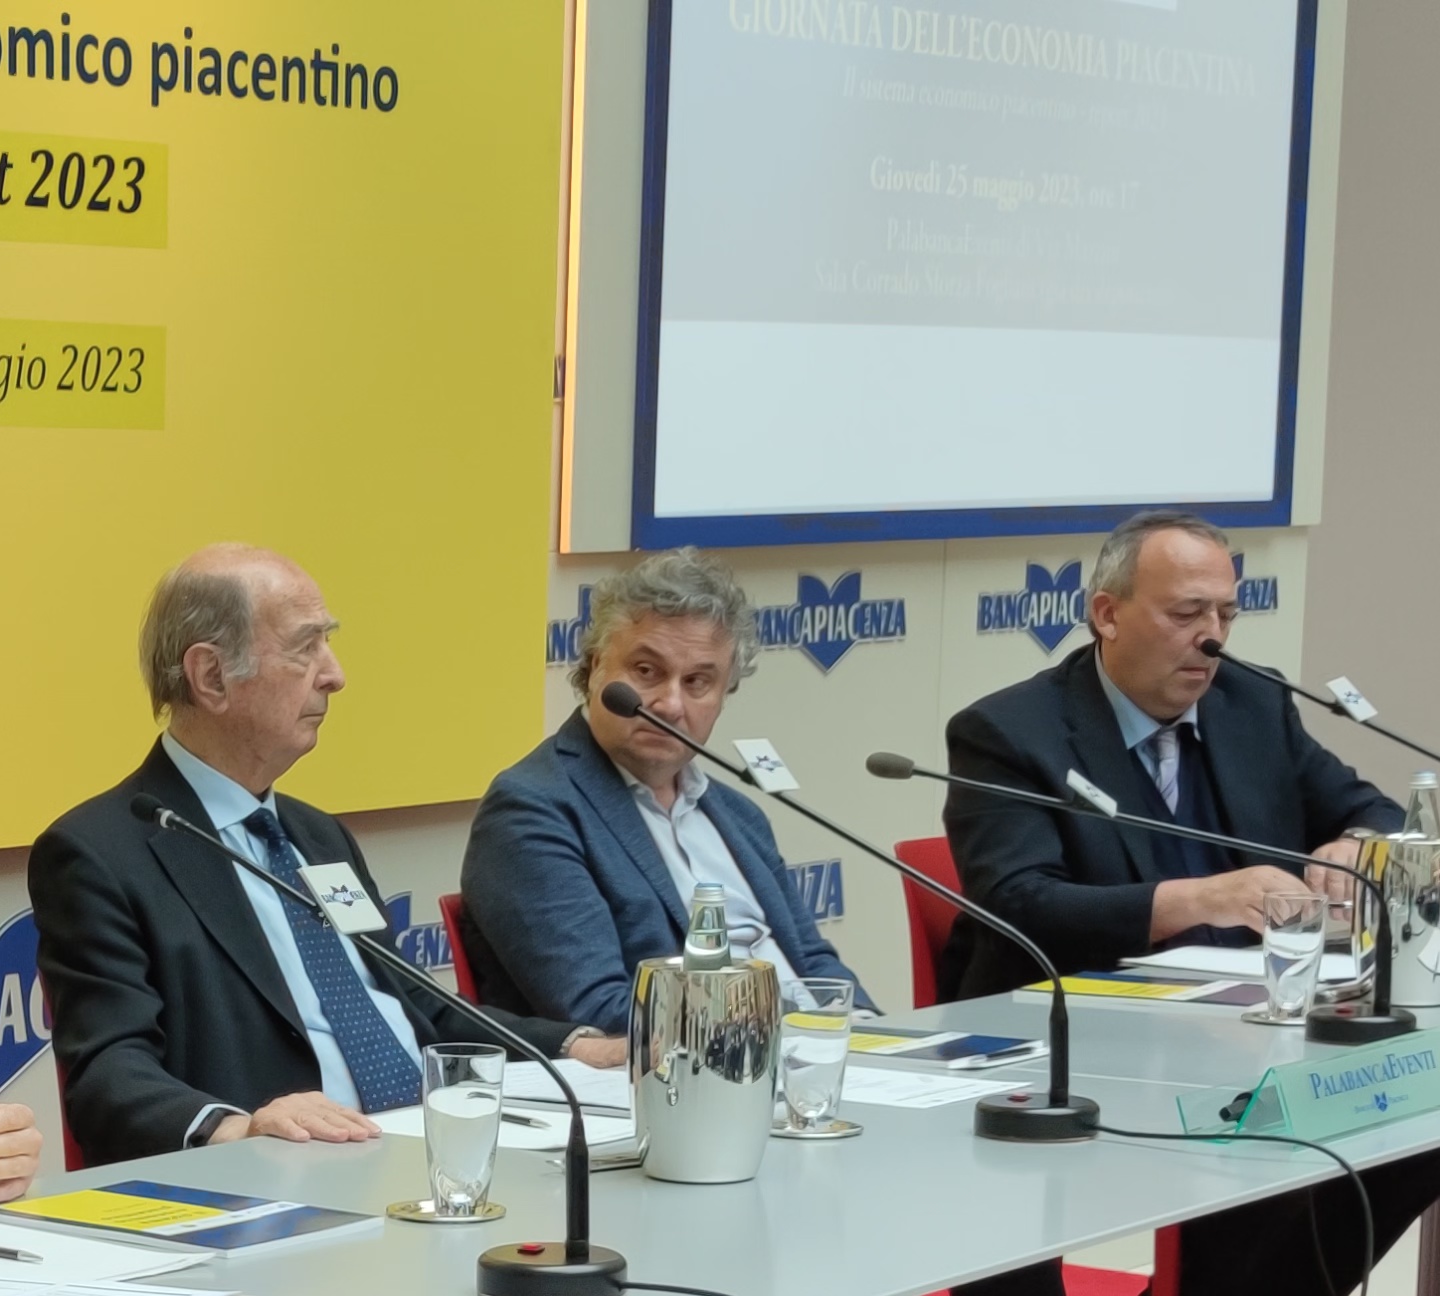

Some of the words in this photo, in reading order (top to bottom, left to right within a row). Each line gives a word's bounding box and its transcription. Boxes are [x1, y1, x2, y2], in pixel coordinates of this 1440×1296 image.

[151, 27, 399, 112] piacentino
[729, 0, 884, 48] GIORNATA
[891, 6, 1109, 79] DELL'ECONOMIA
[1115, 39, 1256, 97] PIACENTINA
[860, 77, 915, 102] sistema
[25, 149, 146, 214] 2023
[946, 163, 968, 198] 25
[972, 168, 1035, 212] maggio
[56, 344, 145, 393] 2023
[755, 598, 906, 645] ANCAPIACENZA
